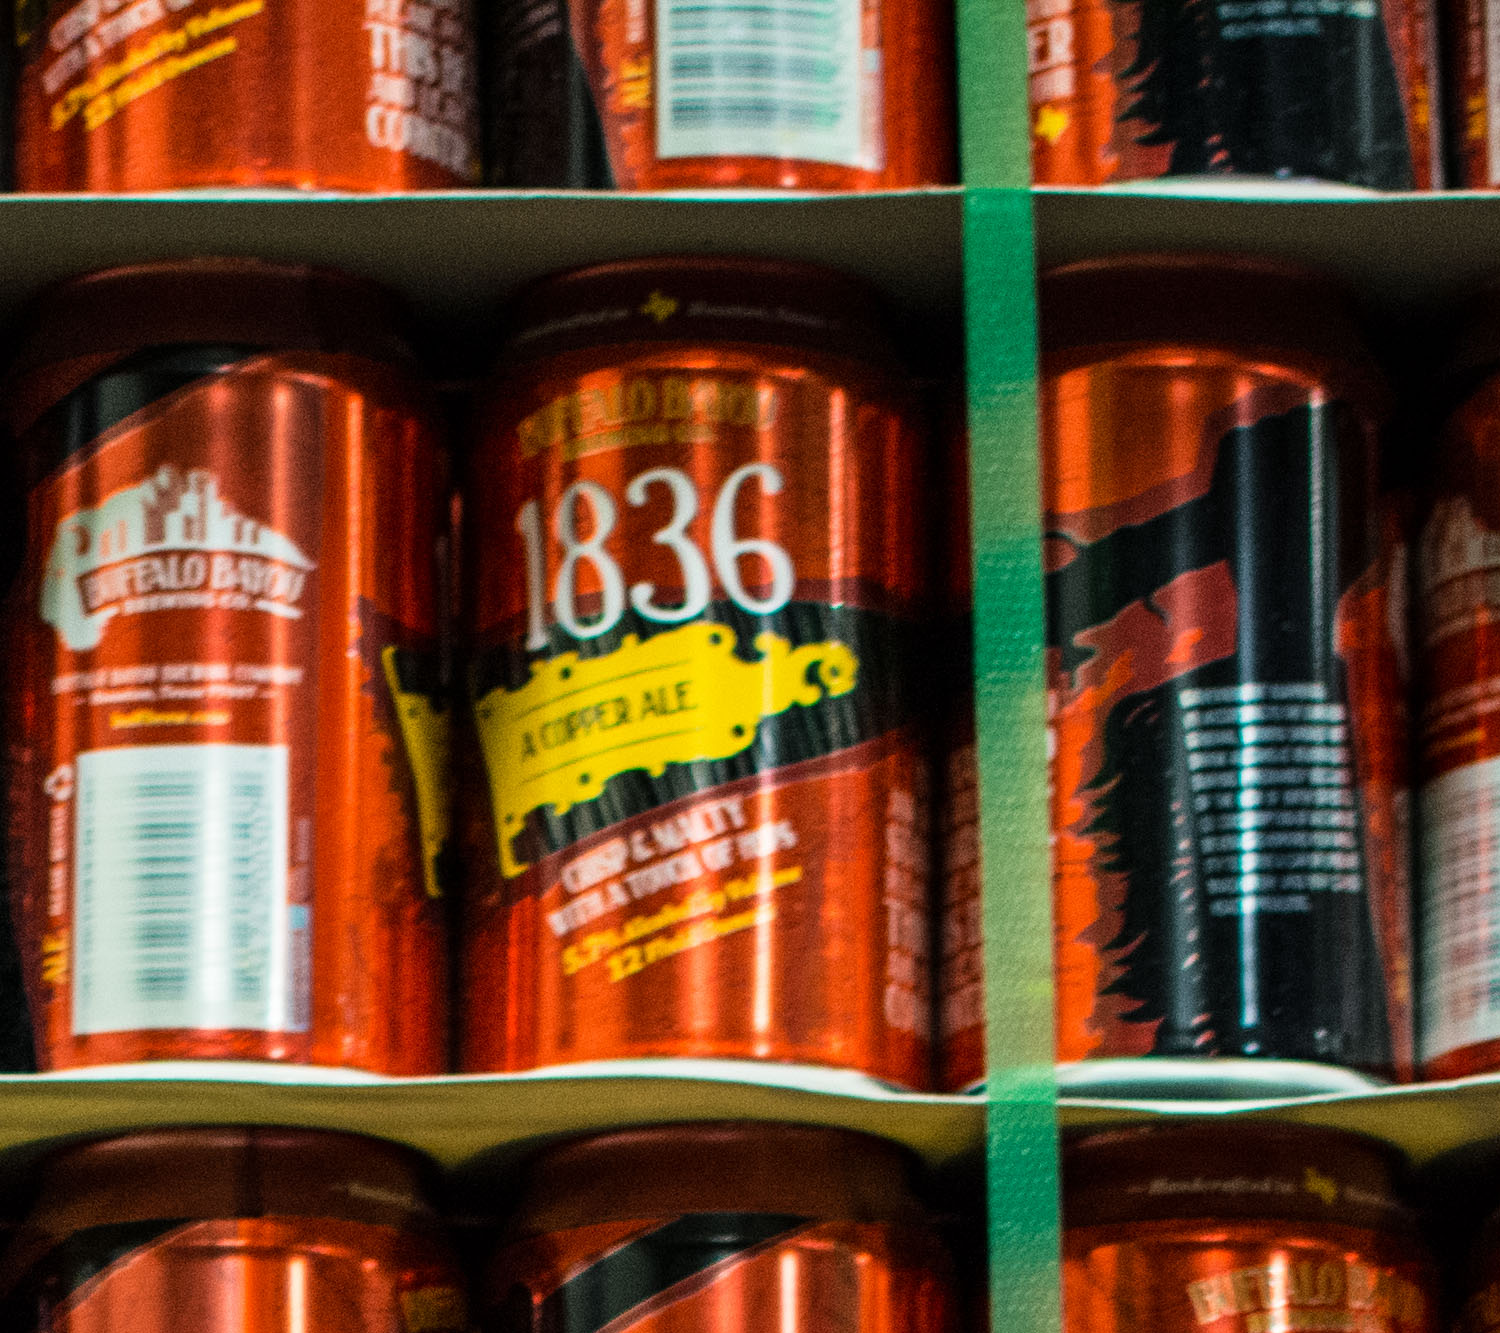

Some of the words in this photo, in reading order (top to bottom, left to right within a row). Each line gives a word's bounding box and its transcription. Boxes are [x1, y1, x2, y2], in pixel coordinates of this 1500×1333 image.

[517, 464, 794, 650] 1836
[546, 700, 630, 753] COPPER
[641, 682, 697, 720] ALE
